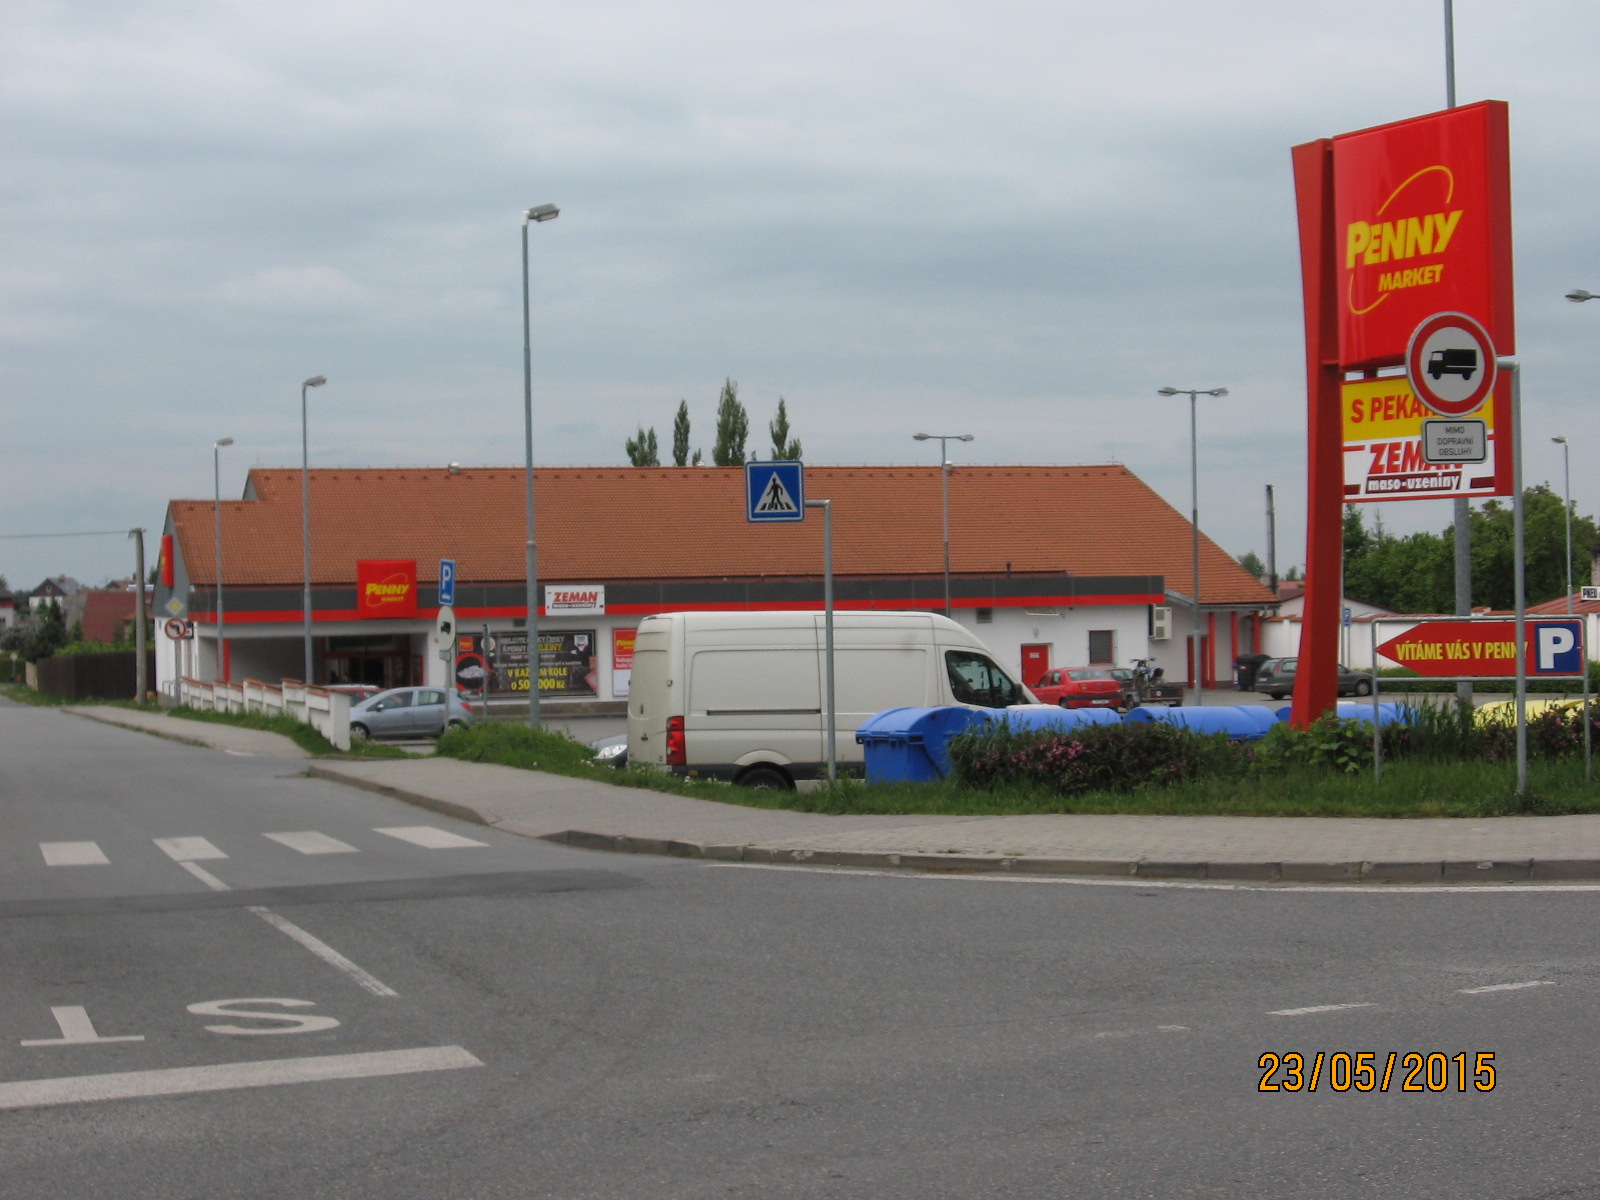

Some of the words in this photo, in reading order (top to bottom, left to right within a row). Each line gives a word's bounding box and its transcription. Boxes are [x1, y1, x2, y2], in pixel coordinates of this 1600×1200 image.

[1346, 210, 1463, 269] PENNY
[1378, 264, 1444, 292] MARKET
[1351, 399, 1364, 423] S
[1445, 426, 1465, 434] MIMO
[365, 583, 409, 595] PENNY
[443, 565, 450, 590] P
[554, 591, 598, 602] ZEMAN
[1396, 640, 1443, 660] VÍTÁME
[1445, 639, 1470, 660] VÁS
[1471, 643, 1483, 659] V
[1539, 627, 1575, 669] P
